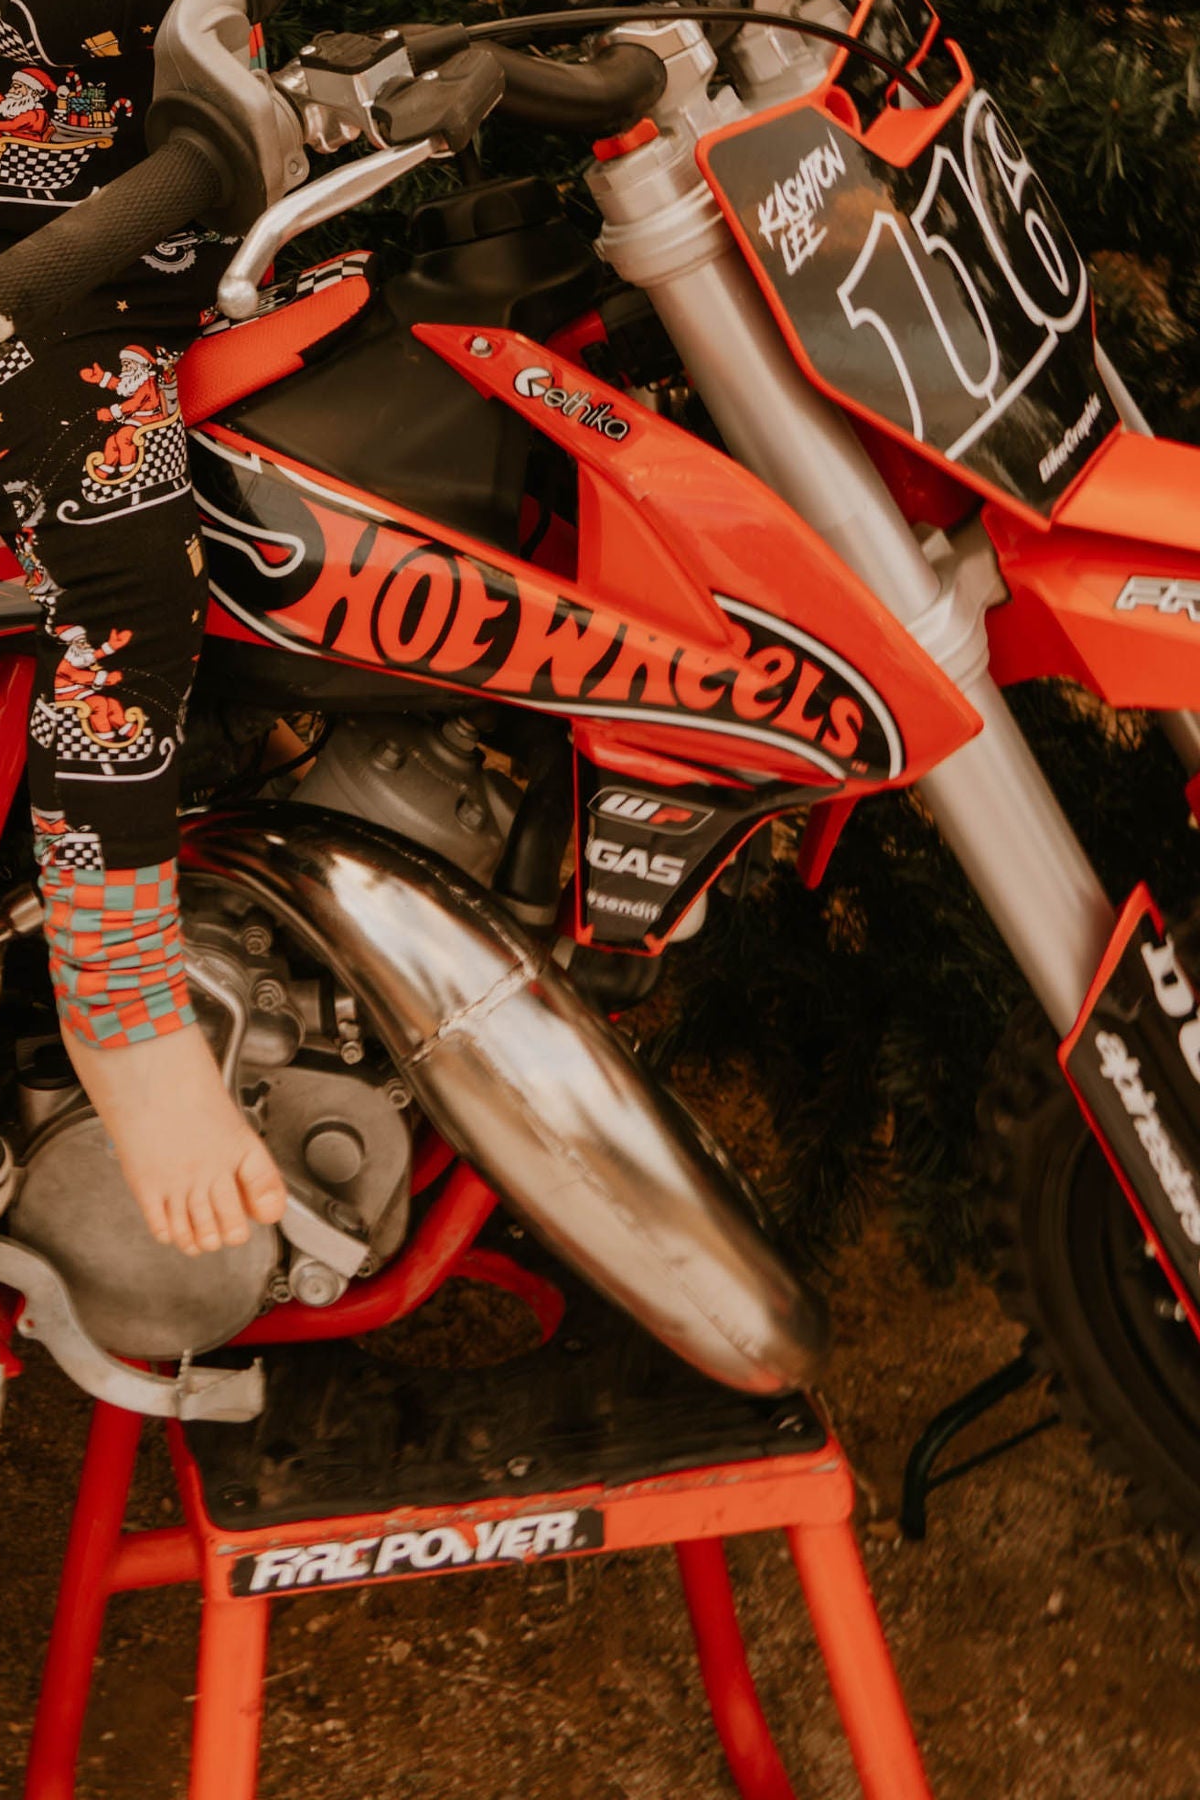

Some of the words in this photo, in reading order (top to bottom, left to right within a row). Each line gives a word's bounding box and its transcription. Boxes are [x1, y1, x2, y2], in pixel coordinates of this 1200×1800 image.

[758, 126, 847, 251] KASHTON
[780, 210, 828, 276] LEE
[837, 89, 1089, 461] 116
[543, 388, 629, 441] ethika
[270, 497, 510, 674] HOT
